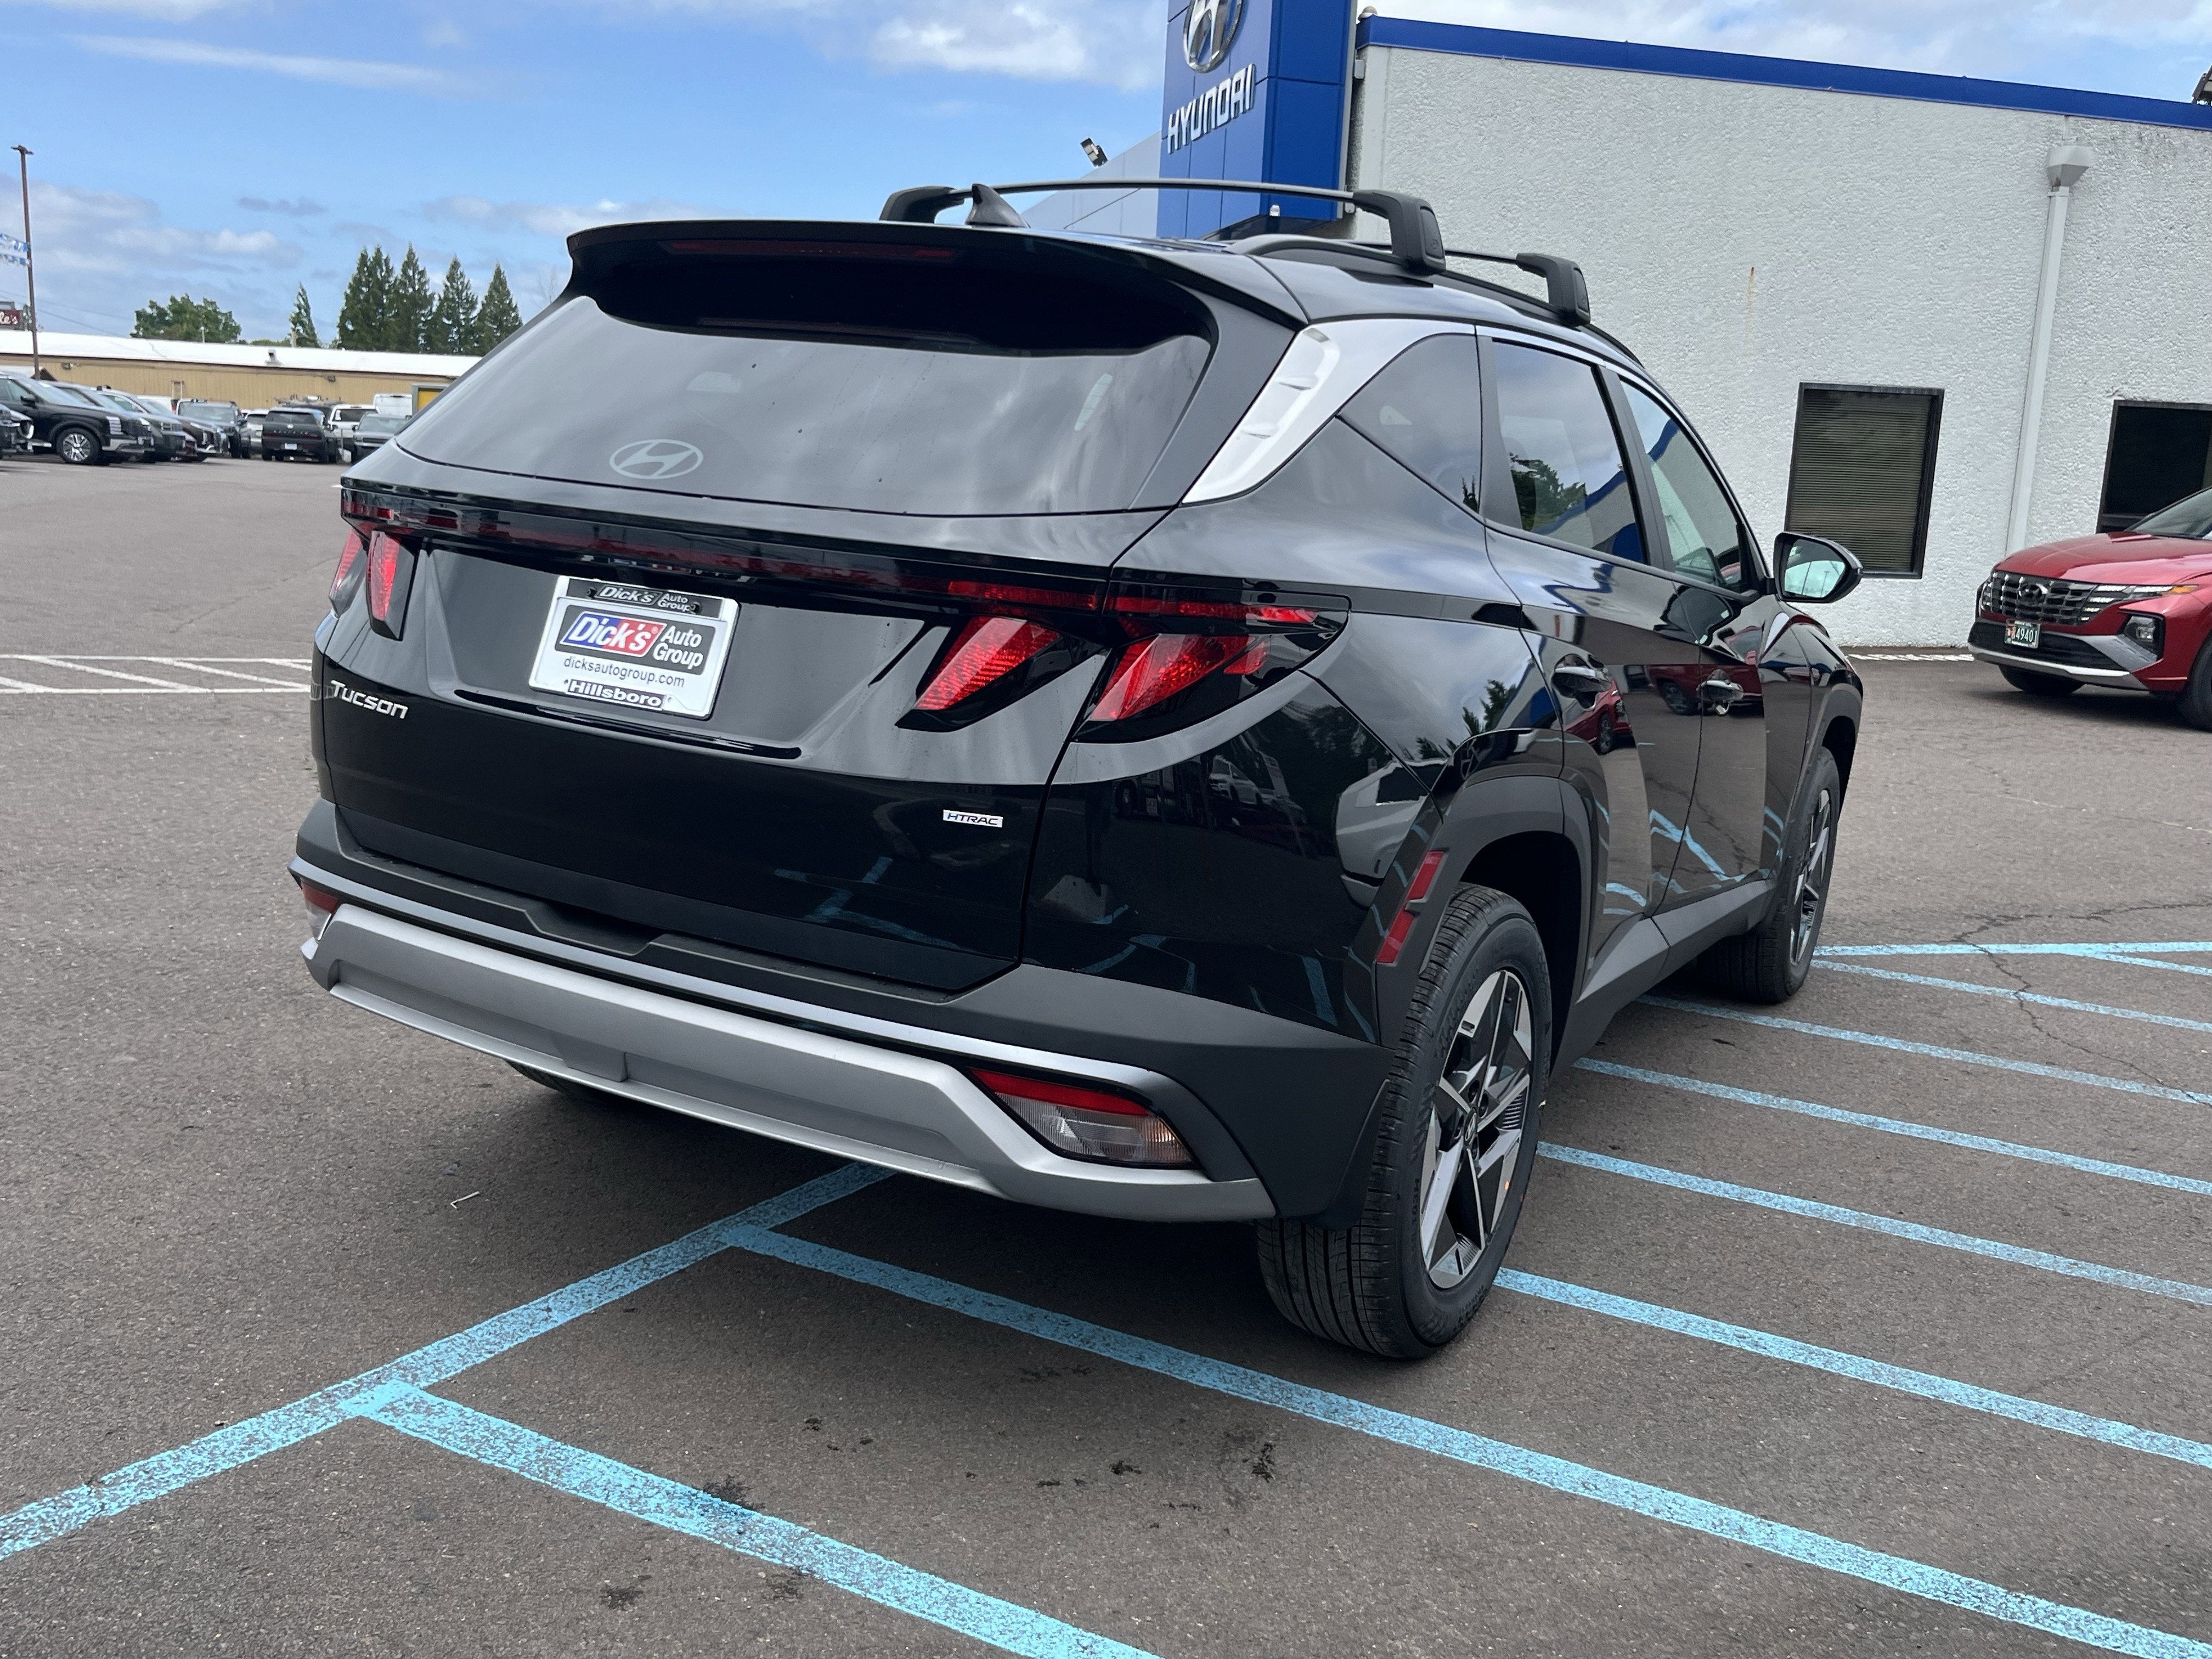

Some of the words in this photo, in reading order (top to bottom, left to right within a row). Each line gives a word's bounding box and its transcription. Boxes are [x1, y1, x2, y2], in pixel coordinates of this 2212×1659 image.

[1167, 63, 1256, 154] HYUNDAI
[599, 586, 654, 603] Dick's
[660, 593, 689, 603] Auto
[568, 616, 652, 651] Dick's
[660, 625, 702, 648] Auto
[653, 642, 704, 670] Group
[564, 656, 685, 687] dicksautogroup.com
[569, 680, 662, 707] Hillsboro
[947, 812, 998, 826] HTRAC
